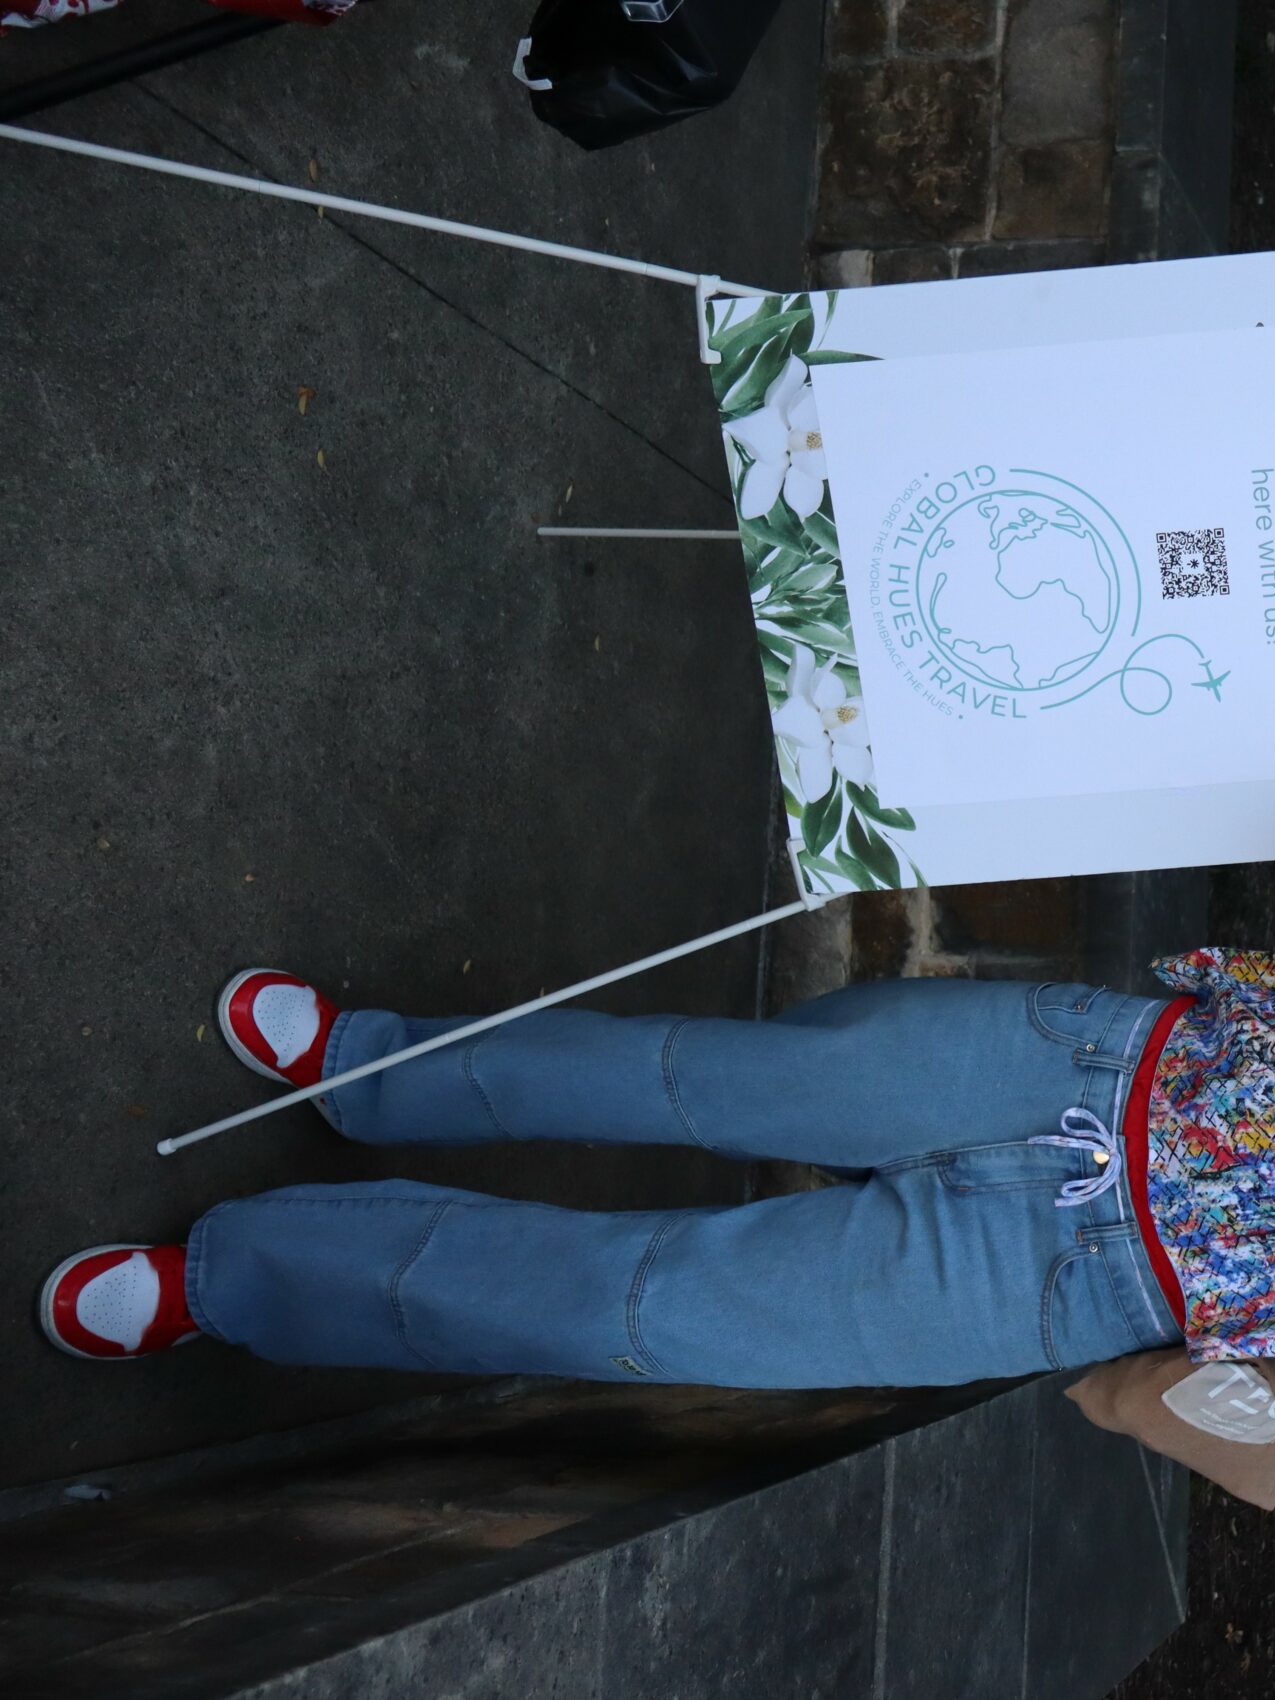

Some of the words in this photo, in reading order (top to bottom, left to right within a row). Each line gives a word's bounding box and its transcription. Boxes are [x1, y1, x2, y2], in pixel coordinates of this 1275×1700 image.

[883, 478, 922, 529] EXPLORE
[893, 465, 996, 549] GLOBAL
[1251, 468, 1274, 530] here
[873, 530, 888, 553] THE
[870, 558, 881, 608] WORLD,
[888, 563, 923, 648] HUES
[872, 611, 903, 670] EMBRACE
[903, 670, 921, 693] THE
[919, 650, 1027, 718] TRAVEL
[922, 690, 954, 715] HUES
